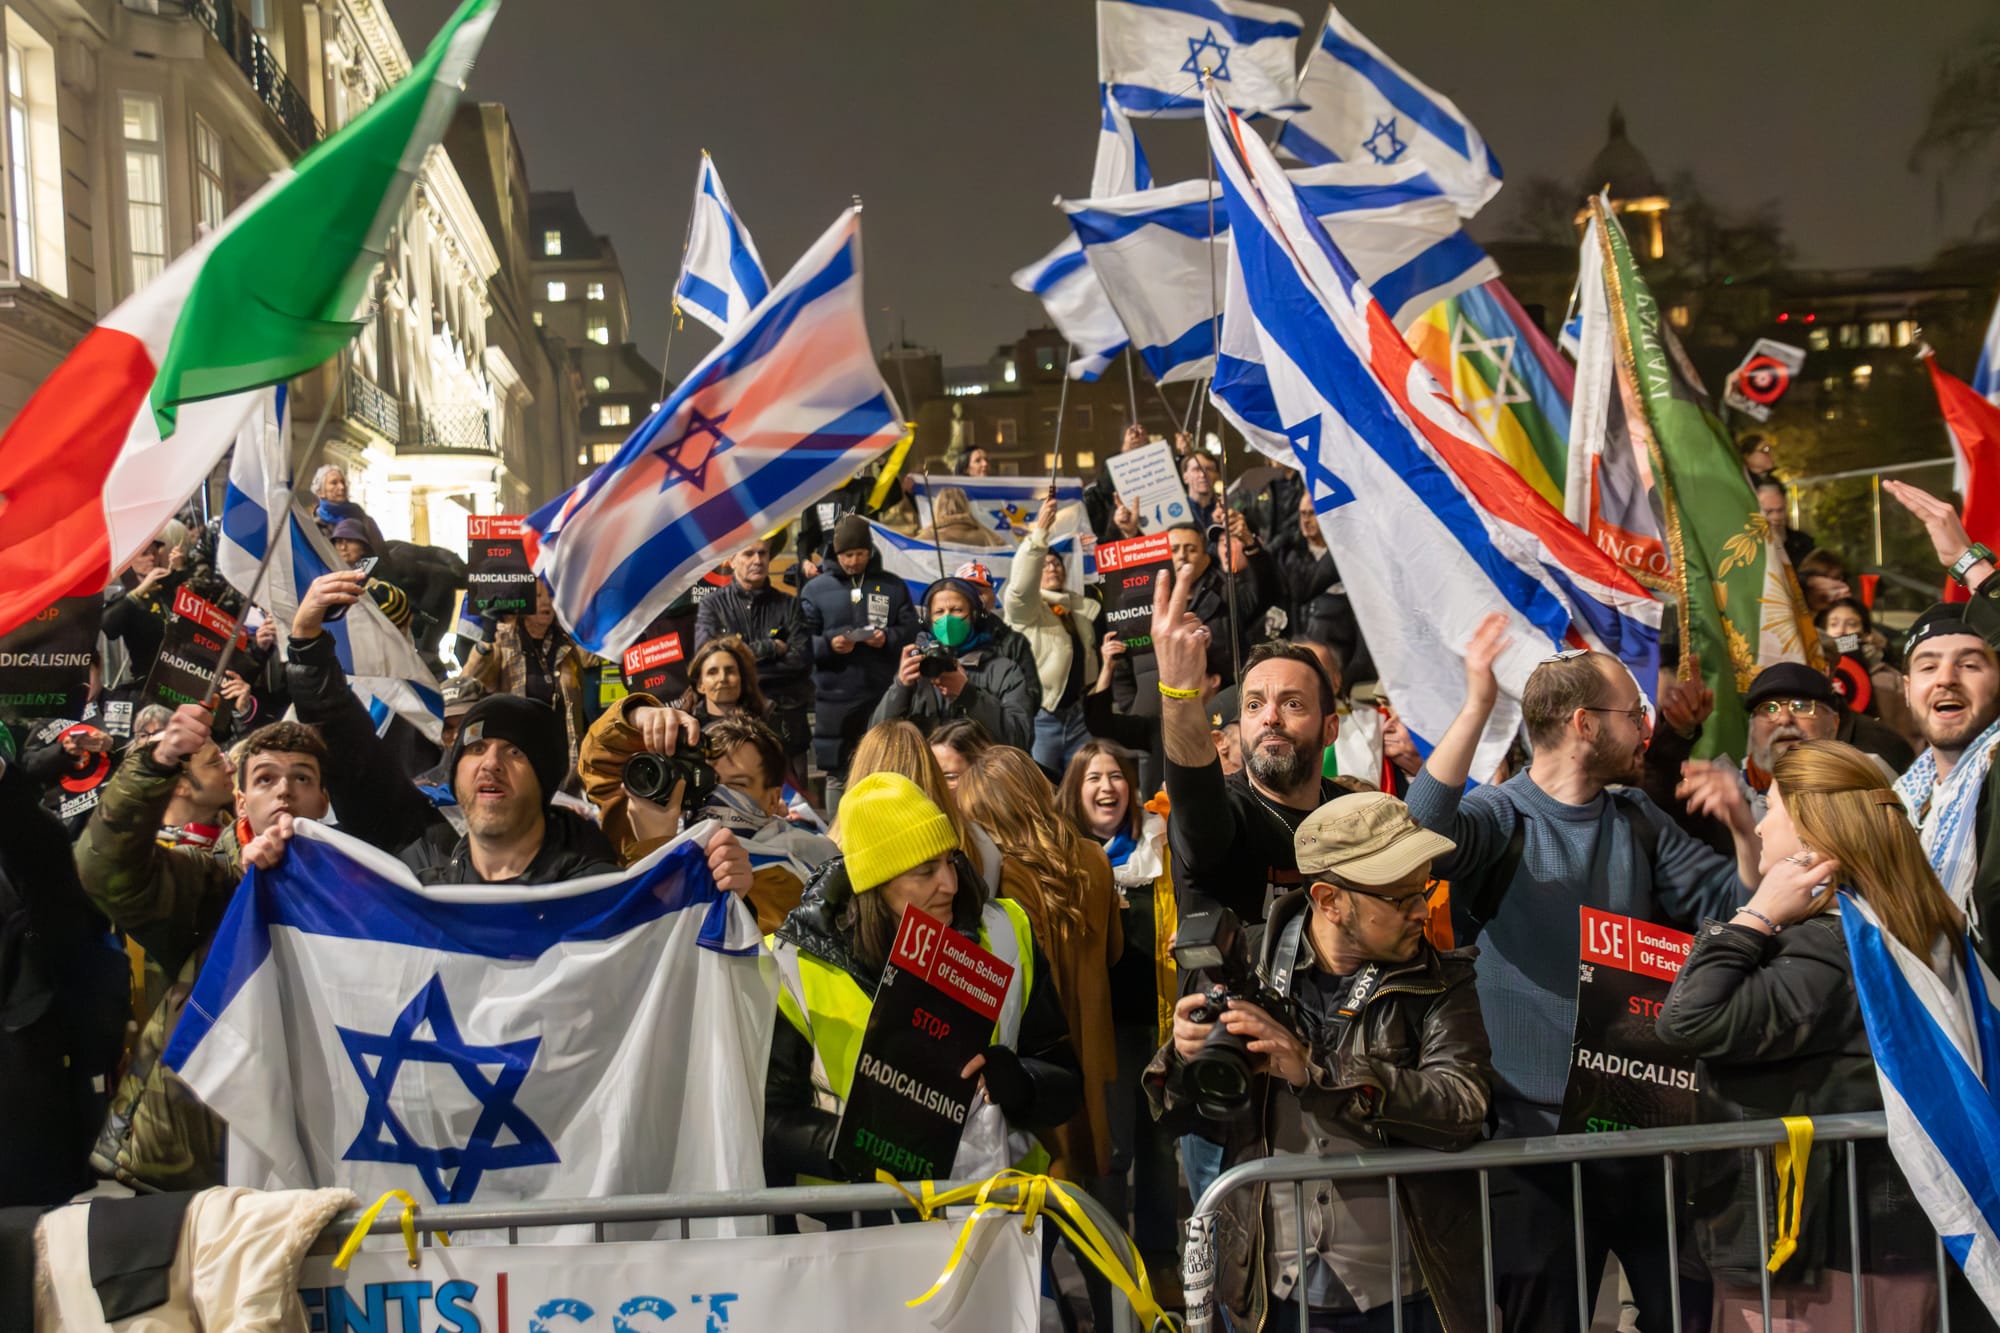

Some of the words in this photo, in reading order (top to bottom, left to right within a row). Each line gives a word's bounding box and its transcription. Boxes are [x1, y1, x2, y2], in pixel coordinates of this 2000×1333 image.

[469, 518, 488, 535] LST
[487, 548, 512, 557] STOP
[1121, 541, 1145, 553] London
[1145, 537, 1168, 549] School
[1098, 547, 1118, 568] LSE
[1124, 554, 1133, 563] Of
[1649, 552, 1669, 574] O
[468, 573, 535, 583] RADICALISING
[1122, 575, 1150, 589] STOP
[36, 608, 60, 621] OP
[180, 592, 202, 617] LST
[1107, 604, 1155, 622] RADICALI
[0, 653, 92, 667] DICALISING
[626, 650, 641, 671] LSE
[643, 675, 667, 689] STOP
[899, 916, 936, 968] LSE
[1588, 917, 1624, 959] LSE
[1637, 930, 1681, 953] London
[1682, 943, 1691, 956] S
[942, 938, 976, 971] London
[976, 960, 1008, 988] School
[1640, 952, 1655, 965] Of
[1656, 956, 1682, 973] Extr
[937, 962, 950, 978] Of
[949, 970, 997, 1008] Extremism
[1348, 963, 1380, 1009] SONY
[911, 1006, 951, 1041] STOP
[859, 1053, 967, 1125] RADICALISING
[854, 1127, 935, 1179] STUDENTS
